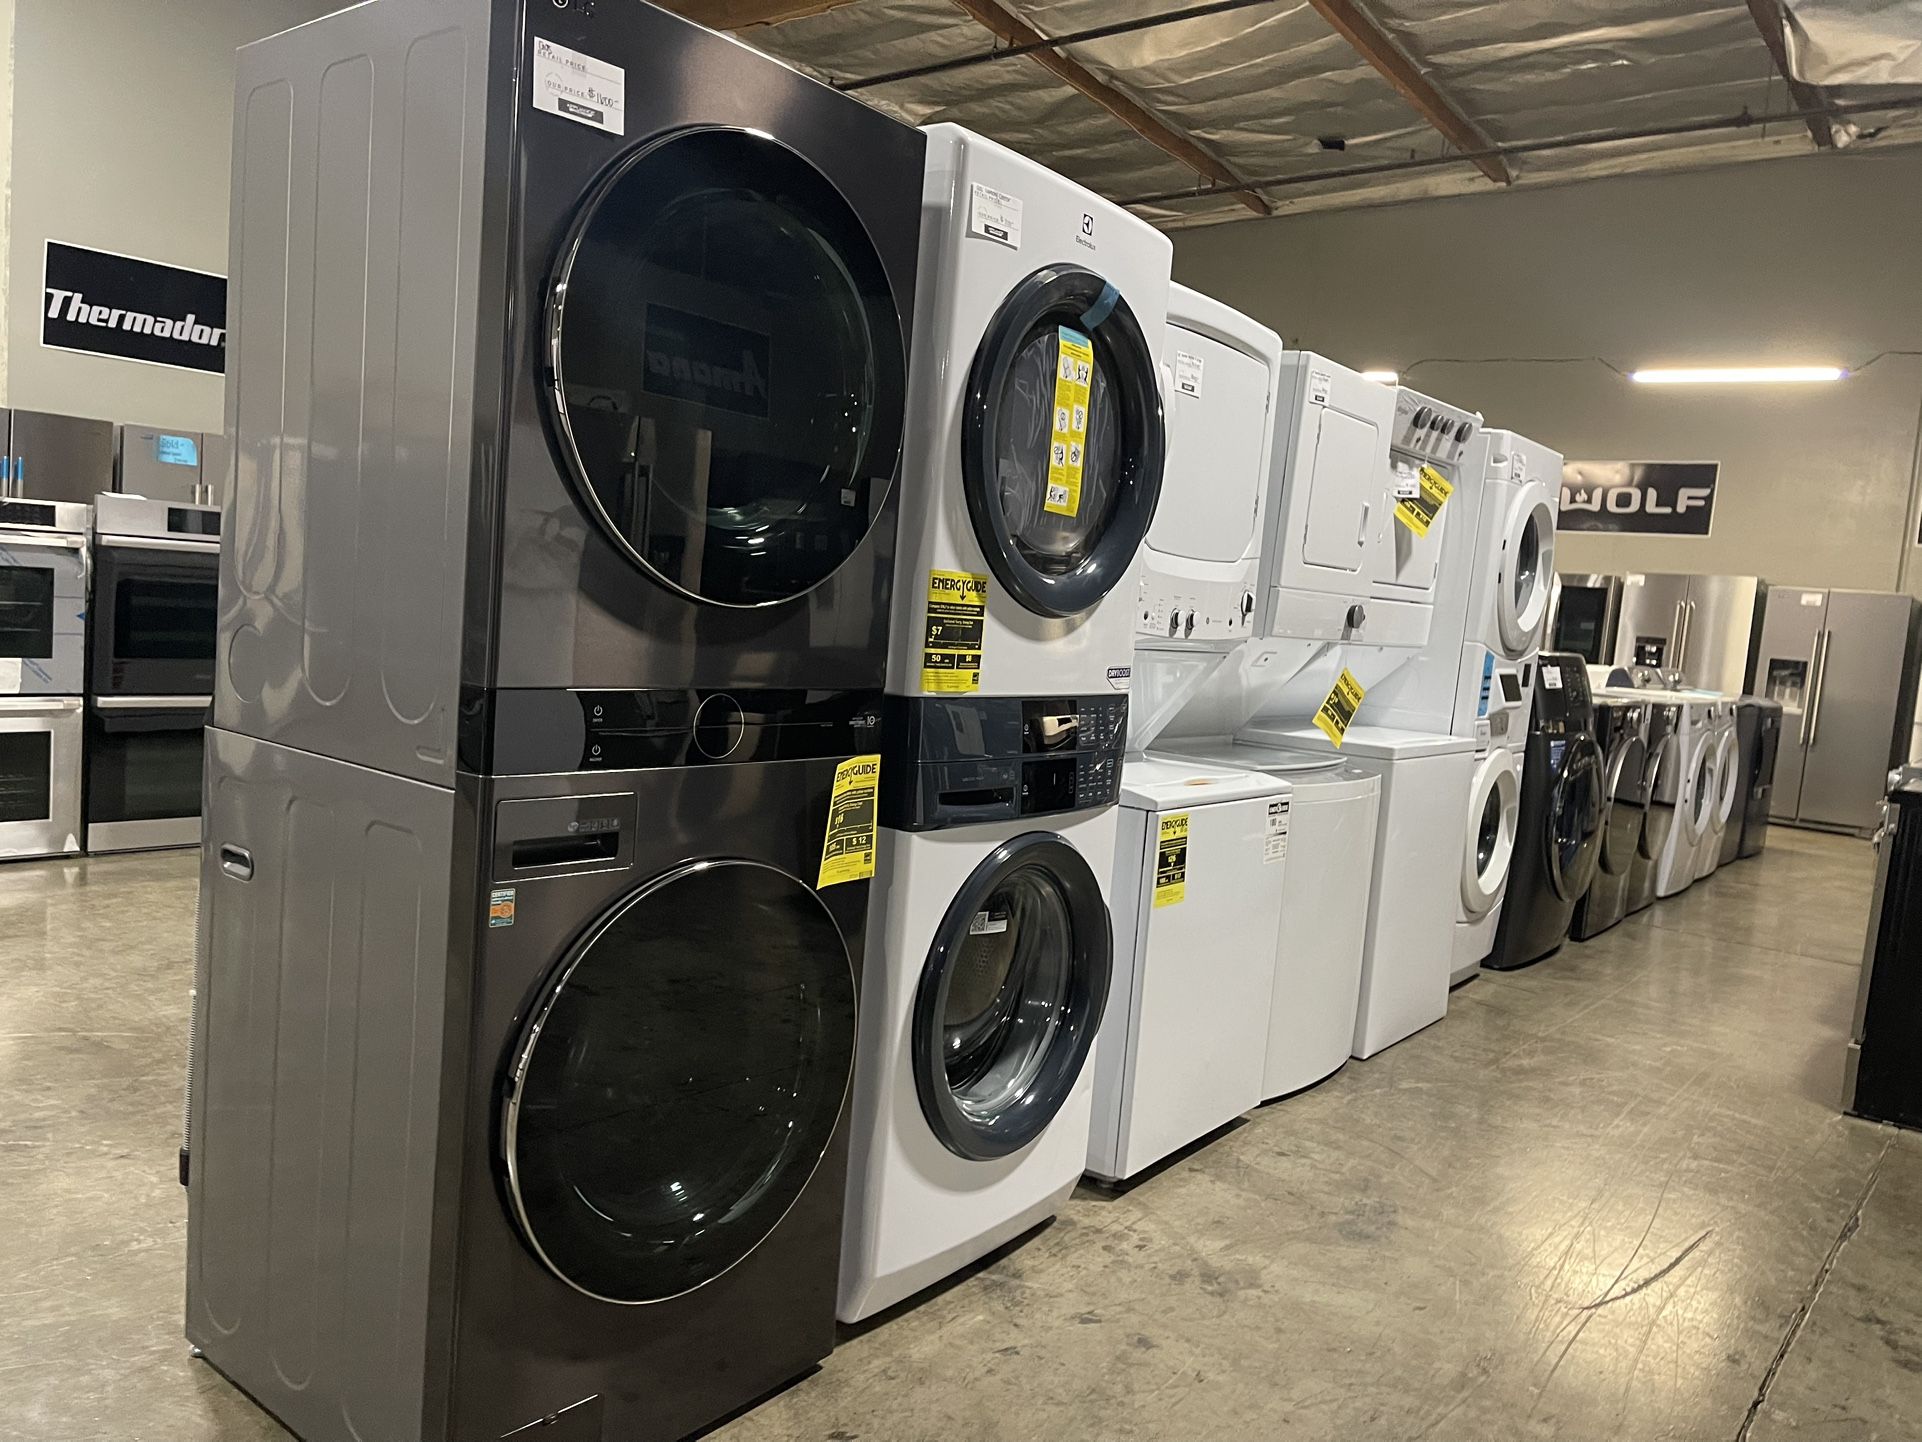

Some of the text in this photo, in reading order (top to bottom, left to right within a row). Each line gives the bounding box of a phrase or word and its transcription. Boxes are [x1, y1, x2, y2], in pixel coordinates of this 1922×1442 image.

[538, 50, 586, 72] RETAIL PRICE
[564, 86, 585, 98] PRICE
[46, 287, 226, 346] Thermador
[1560, 486, 1711, 514] WOLF
[931, 625, 943, 636] $7
